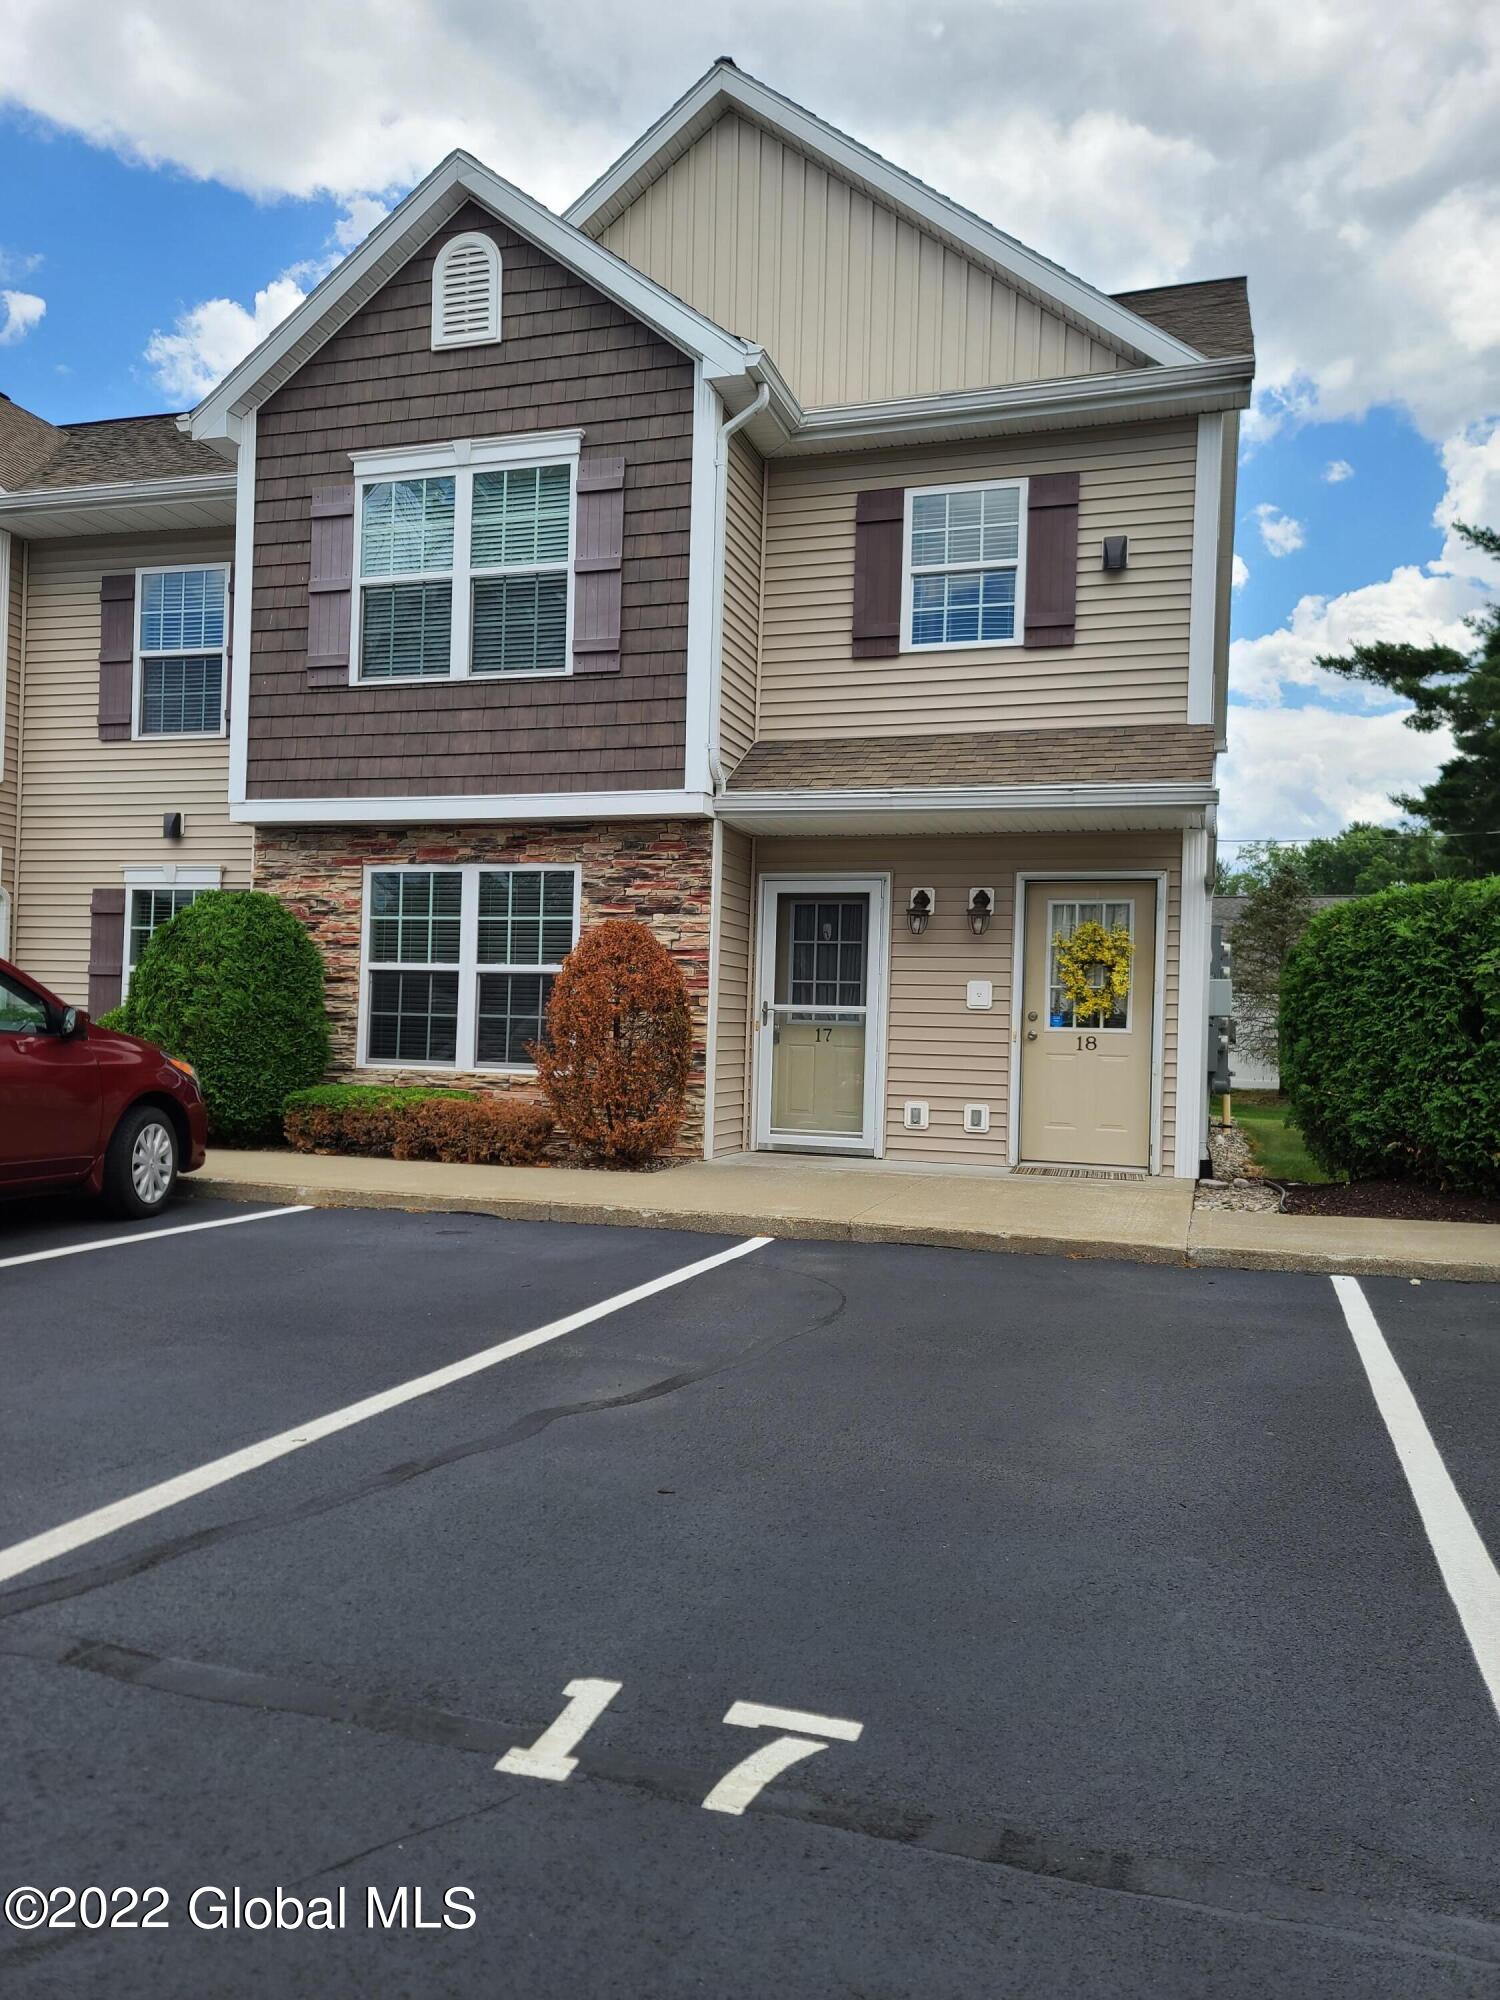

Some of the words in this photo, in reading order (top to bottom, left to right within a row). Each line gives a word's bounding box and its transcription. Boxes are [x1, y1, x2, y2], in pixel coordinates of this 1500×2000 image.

[815, 1027, 833, 1043] 17
[1076, 1035, 1098, 1051] 18
[494, 1677, 864, 1816] 17
